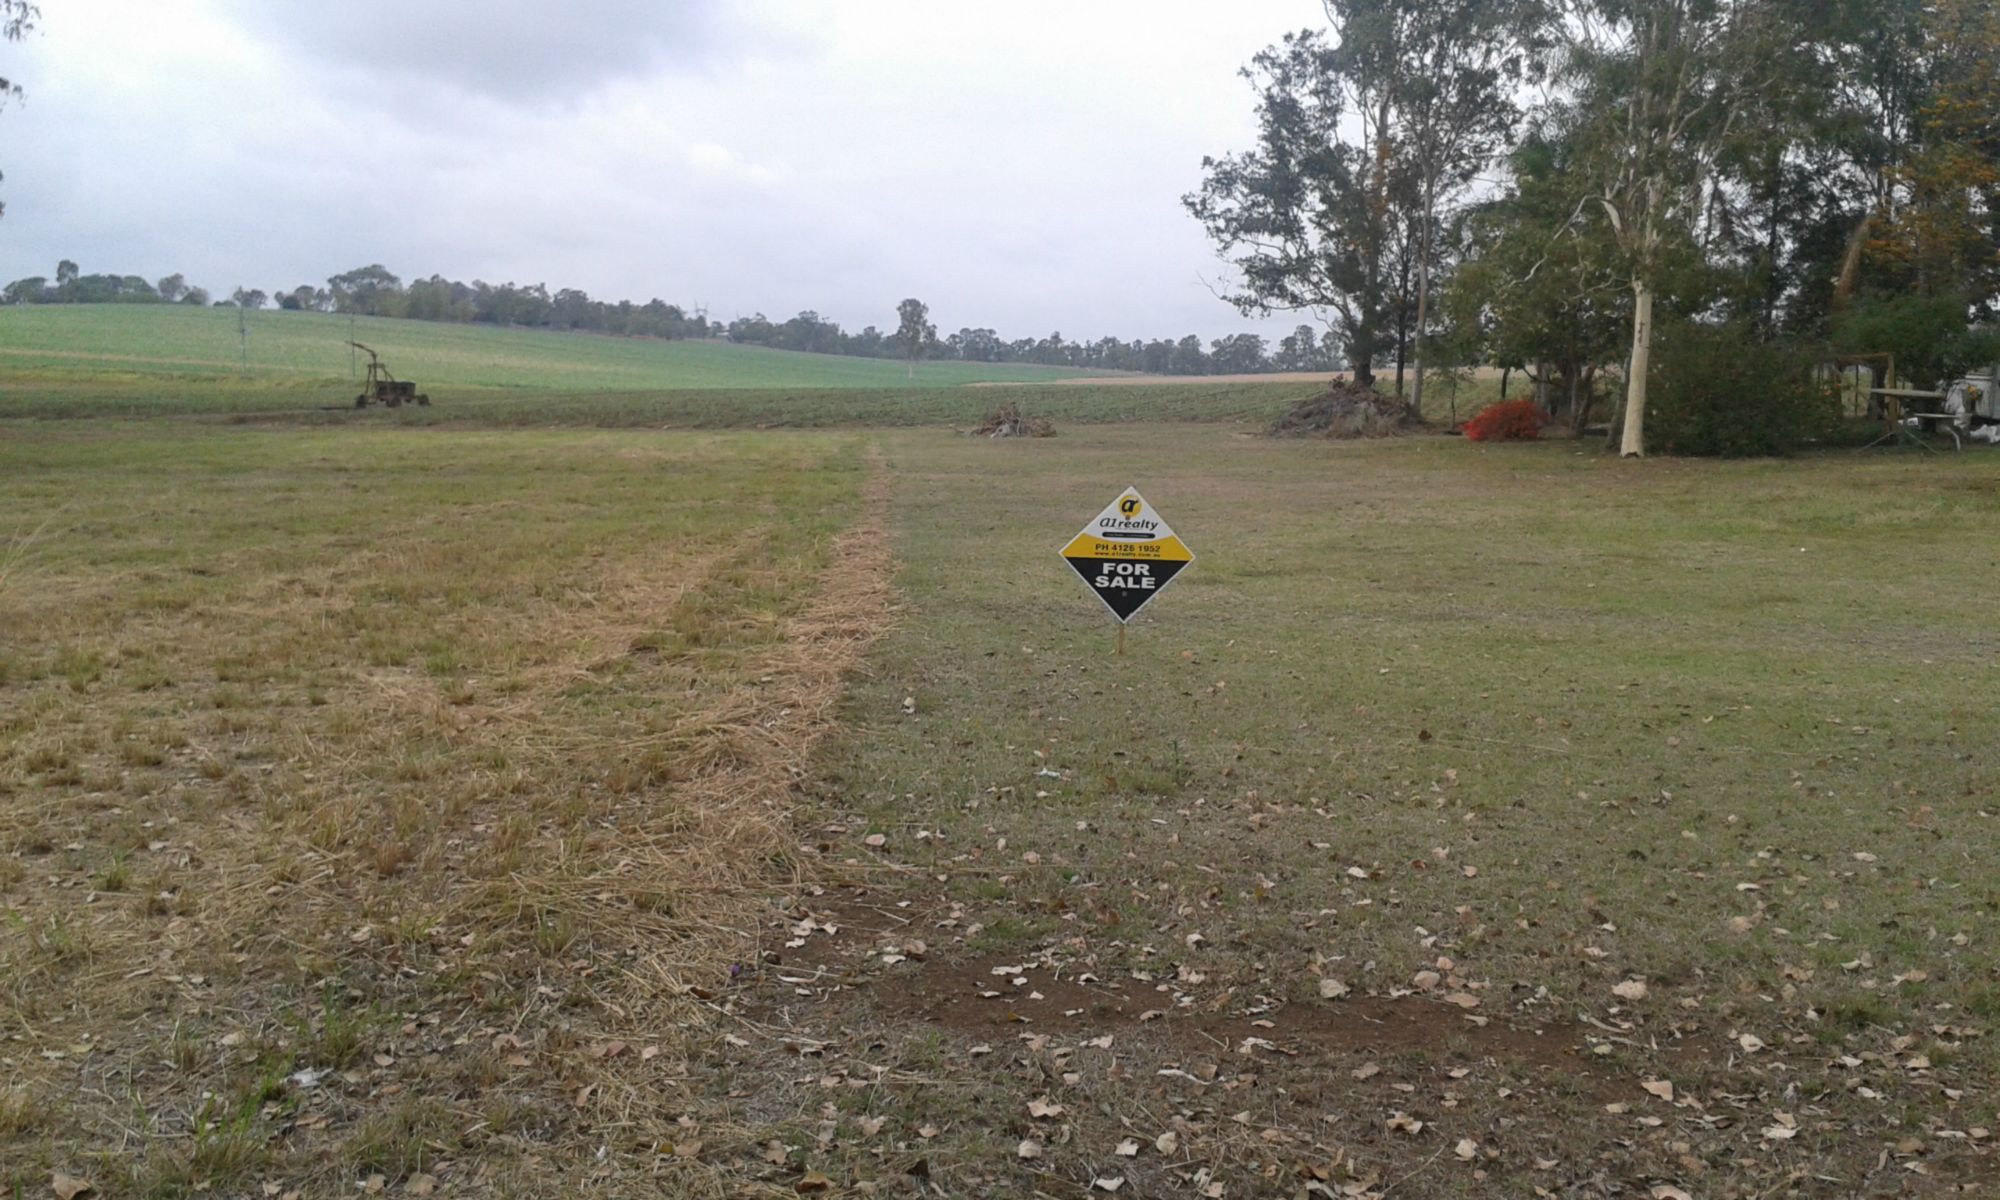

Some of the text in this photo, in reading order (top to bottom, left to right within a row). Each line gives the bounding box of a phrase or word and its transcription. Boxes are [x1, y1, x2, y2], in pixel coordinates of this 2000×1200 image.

[1095, 543, 1109, 551] PH
[1138, 545, 1160, 553] 1952
[1102, 563, 1150, 576] FOR
[1095, 575, 1156, 589] SALE
